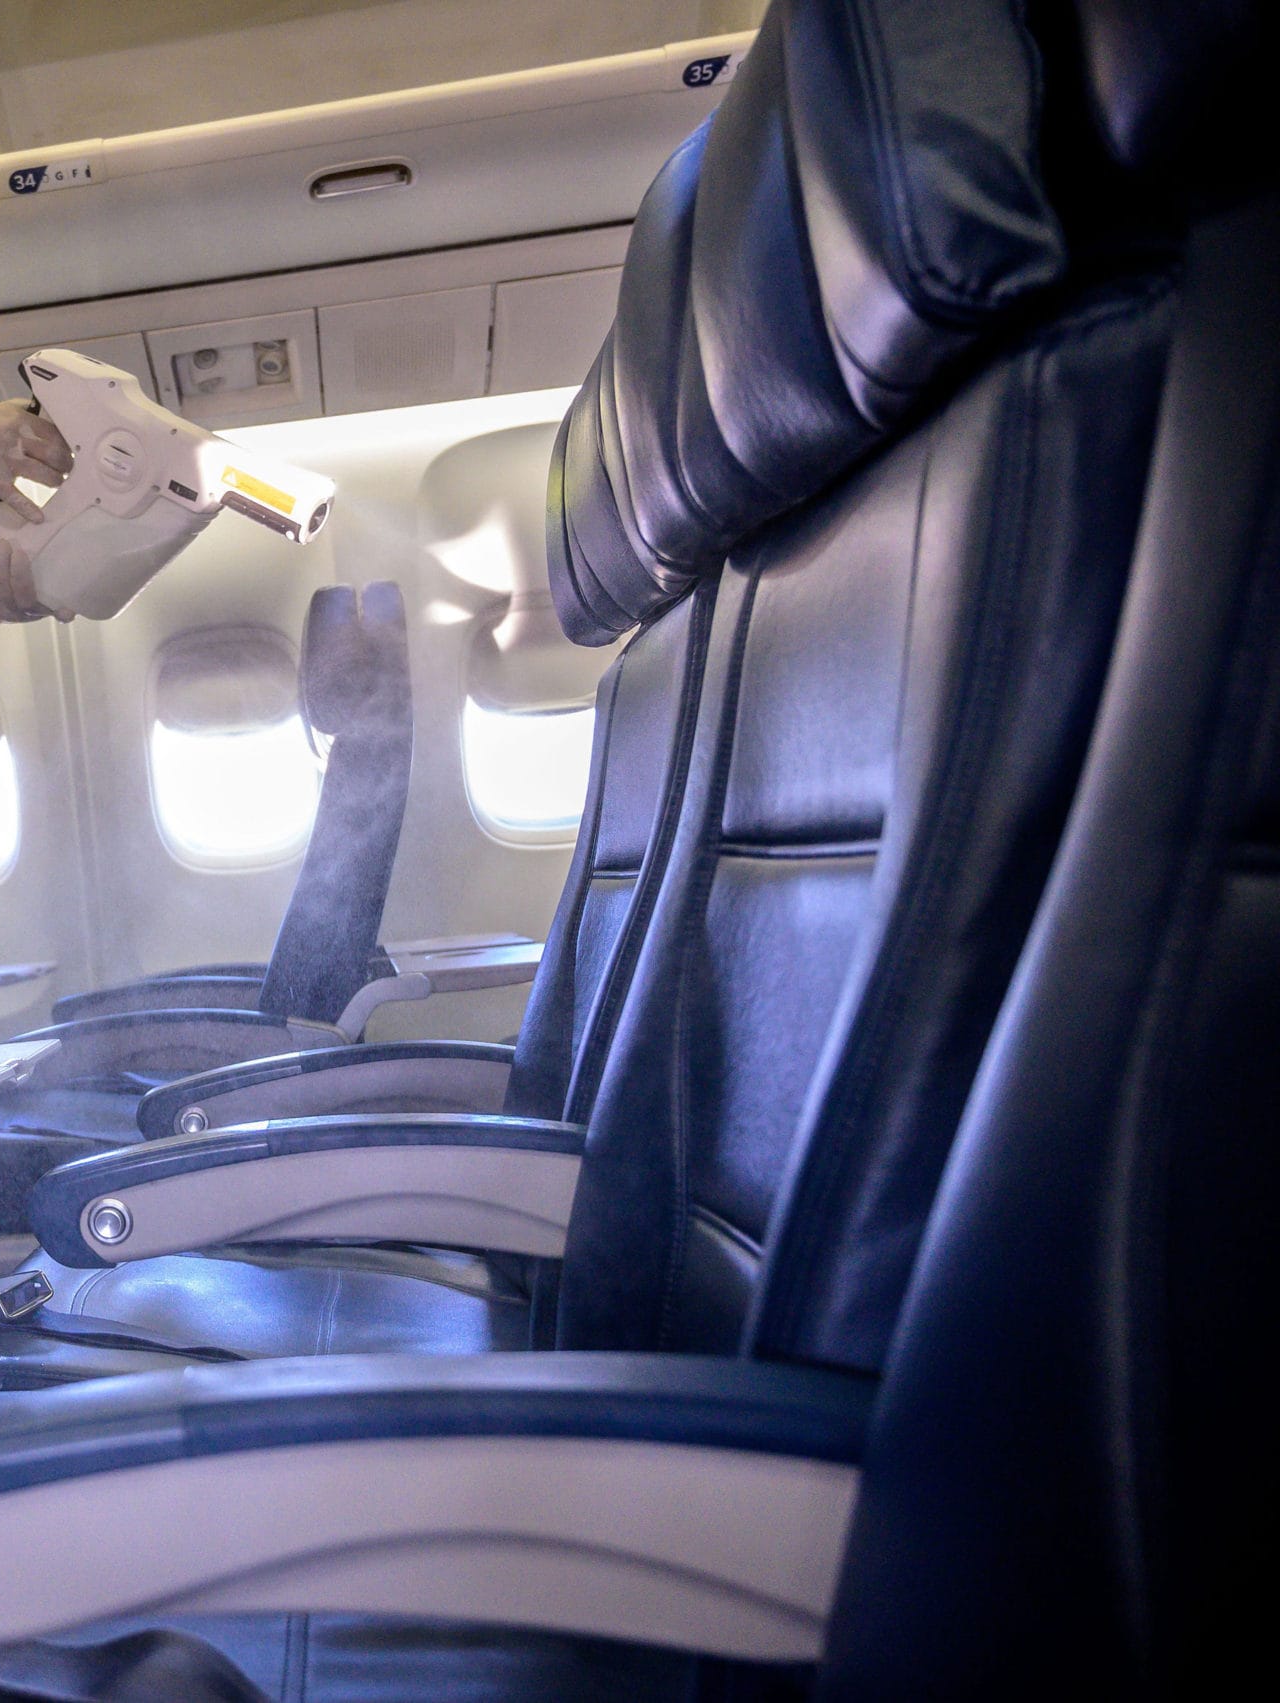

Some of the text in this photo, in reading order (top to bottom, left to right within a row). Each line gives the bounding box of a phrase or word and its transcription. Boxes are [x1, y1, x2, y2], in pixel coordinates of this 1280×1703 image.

[690, 64, 713, 83] 35
[14, 169, 78, 190] 34 G F
